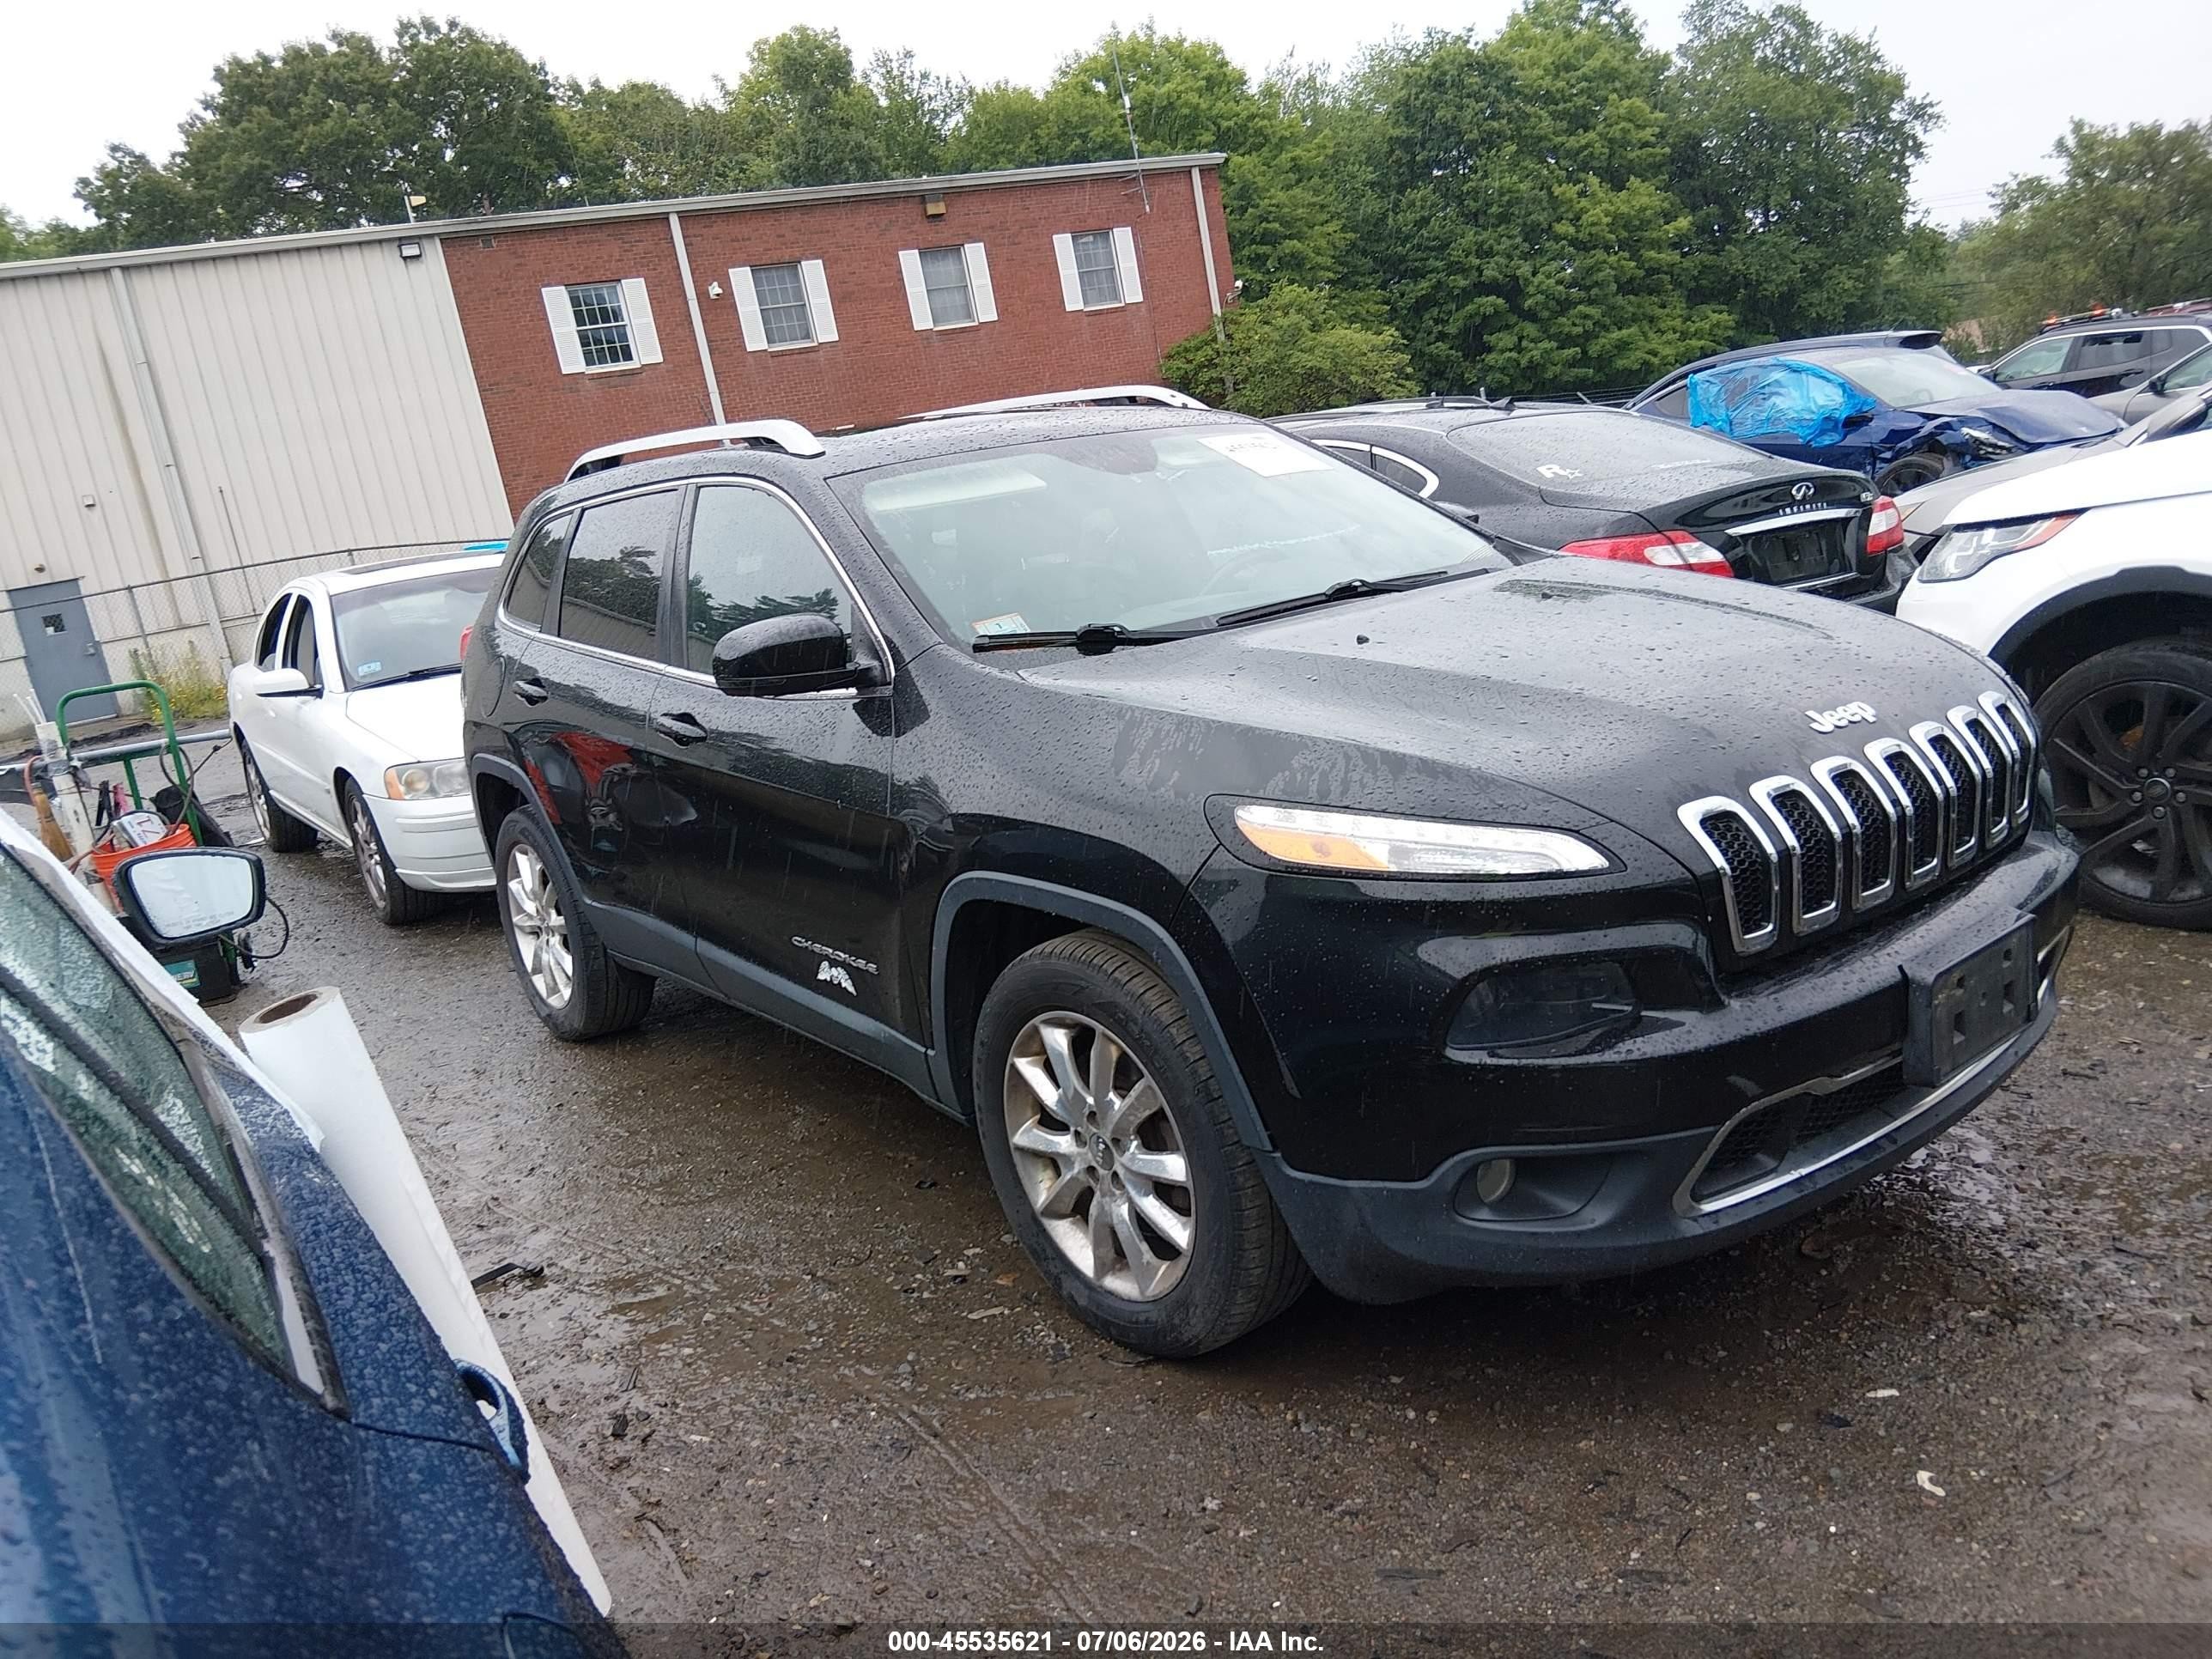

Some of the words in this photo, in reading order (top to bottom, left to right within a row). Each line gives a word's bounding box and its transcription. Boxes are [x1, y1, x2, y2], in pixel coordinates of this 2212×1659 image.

[1778, 502, 1826, 516] INFINITI
[1804, 701, 1877, 733] Jeep
[791, 936, 879, 975] CHEROKEE
